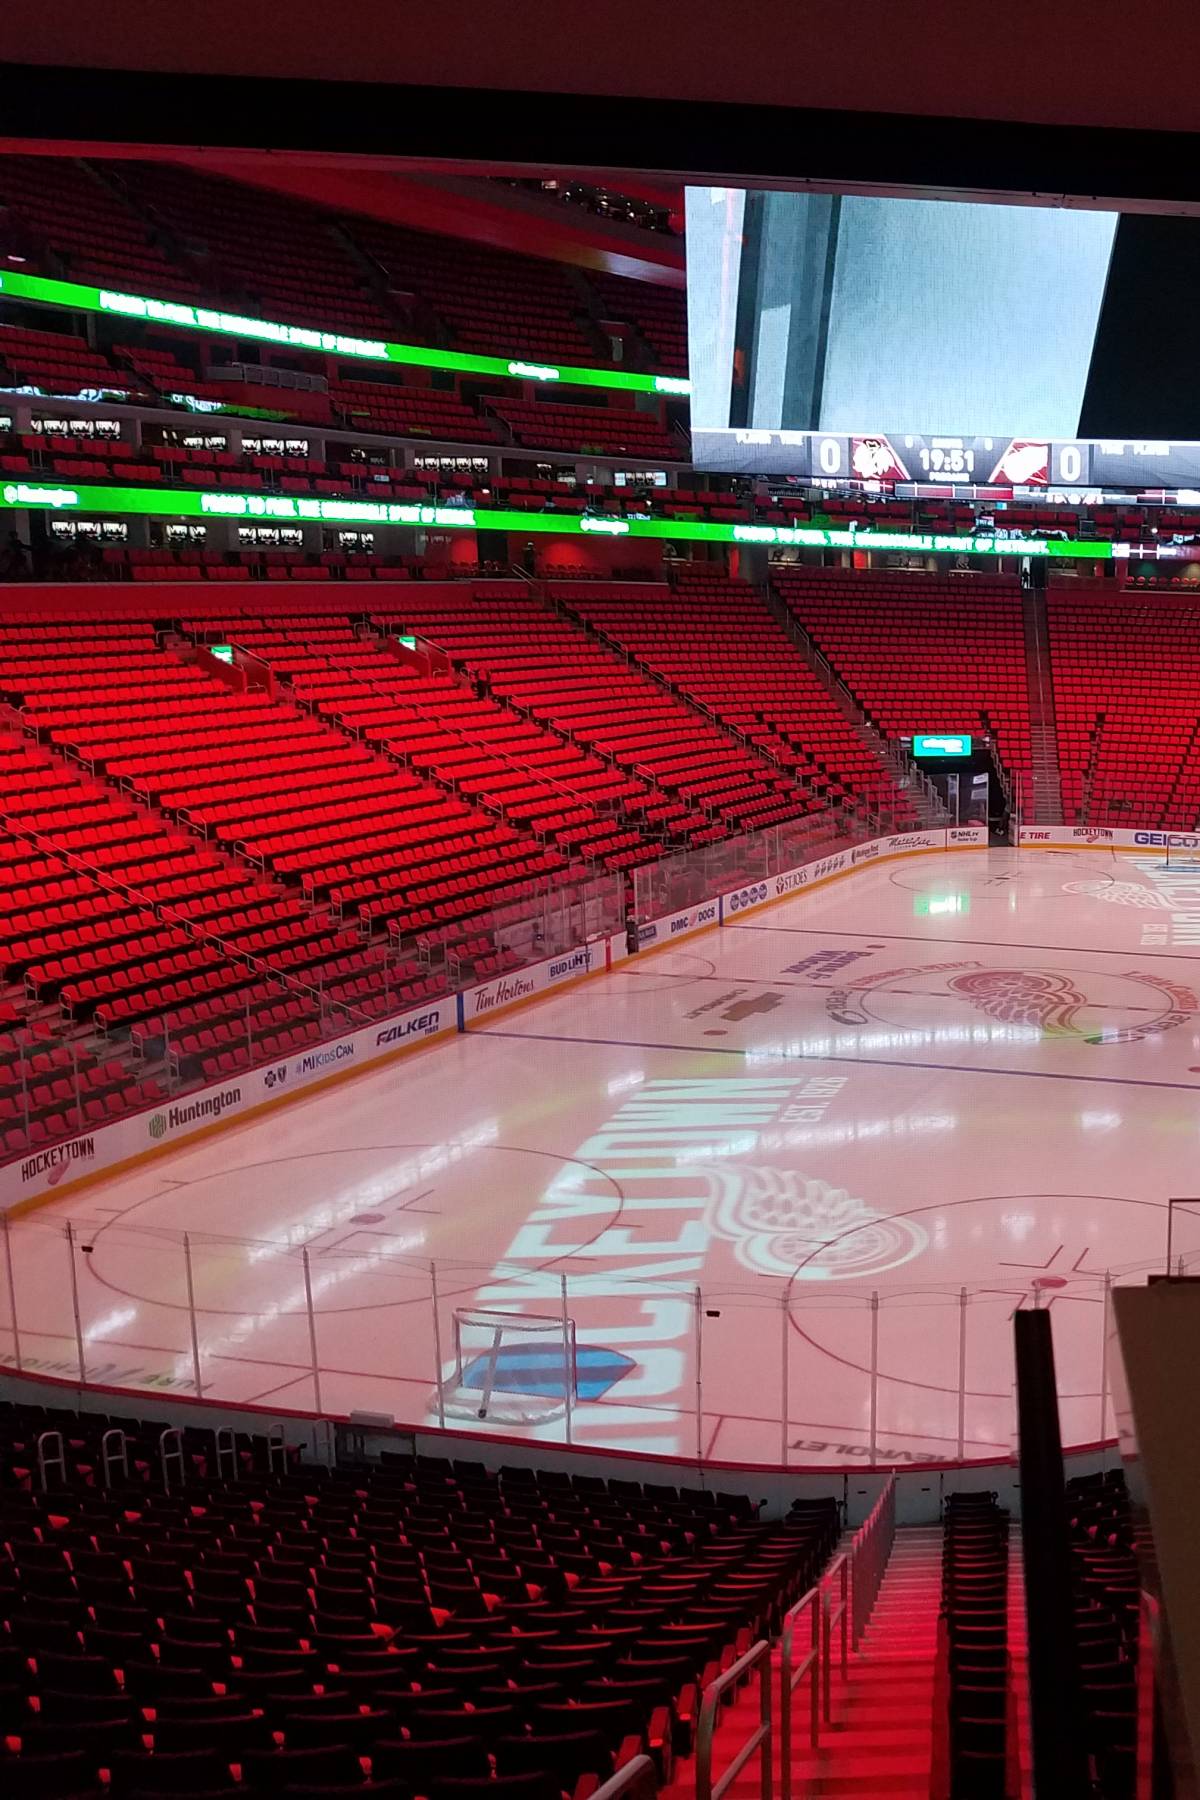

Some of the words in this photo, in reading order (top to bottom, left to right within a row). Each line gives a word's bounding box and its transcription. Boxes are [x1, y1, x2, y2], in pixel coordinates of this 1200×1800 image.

[819, 438, 841, 474] 0
[919, 448, 975, 472] 19:51
[1060, 446, 1081, 482] 0
[1029, 832, 1050, 840] TIRE
[1073, 828, 1113, 838] HOCKEYTOWN
[1134, 832, 1198, 847] GEICO
[671, 916, 689, 933] DMC
[698, 907, 715, 922] DOCS
[549, 962, 568, 977] BUD
[474, 985, 495, 1012] Tim
[495, 978, 534, 1004] Hortons
[376, 1011, 440, 1047] FALKEN
[796, 1076, 850, 1104] 1926
[168, 1087, 241, 1129] Huntington
[21, 1137, 95, 1182] HOCKEYTOWN
